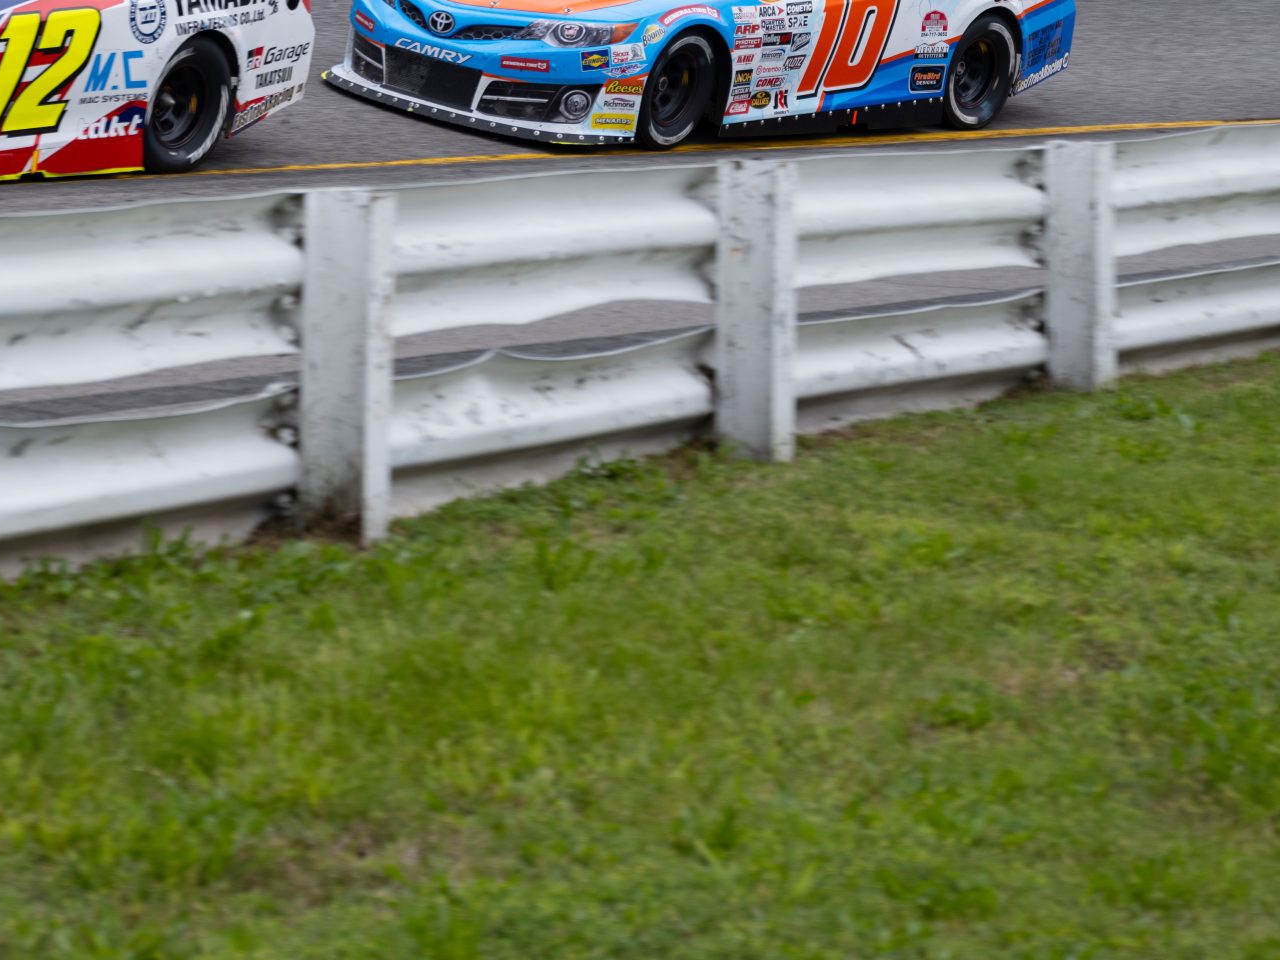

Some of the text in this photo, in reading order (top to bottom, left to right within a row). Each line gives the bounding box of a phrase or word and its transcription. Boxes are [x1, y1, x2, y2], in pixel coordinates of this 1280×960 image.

[759, 5, 776, 17] ARCA
[787, 4, 812, 14] COMETIC
[735, 24, 760, 35] ARP
[642, 26, 667, 48] Bounty
[263, 41, 311, 65] Garage
[393, 37, 474, 65] CAMRY
[915, 45, 949, 54] PIEDMONT
[582, 56, 609, 67] SUNOCO
[763, 65, 781, 73] brembo
[914, 72, 942, 81] FireBird
[606, 80, 643, 94] Reese's
[79, 92, 148, 105] MAC SYSTEMS
[604, 100, 635, 108] Richmond
[595, 117, 632, 126] MENARDS
